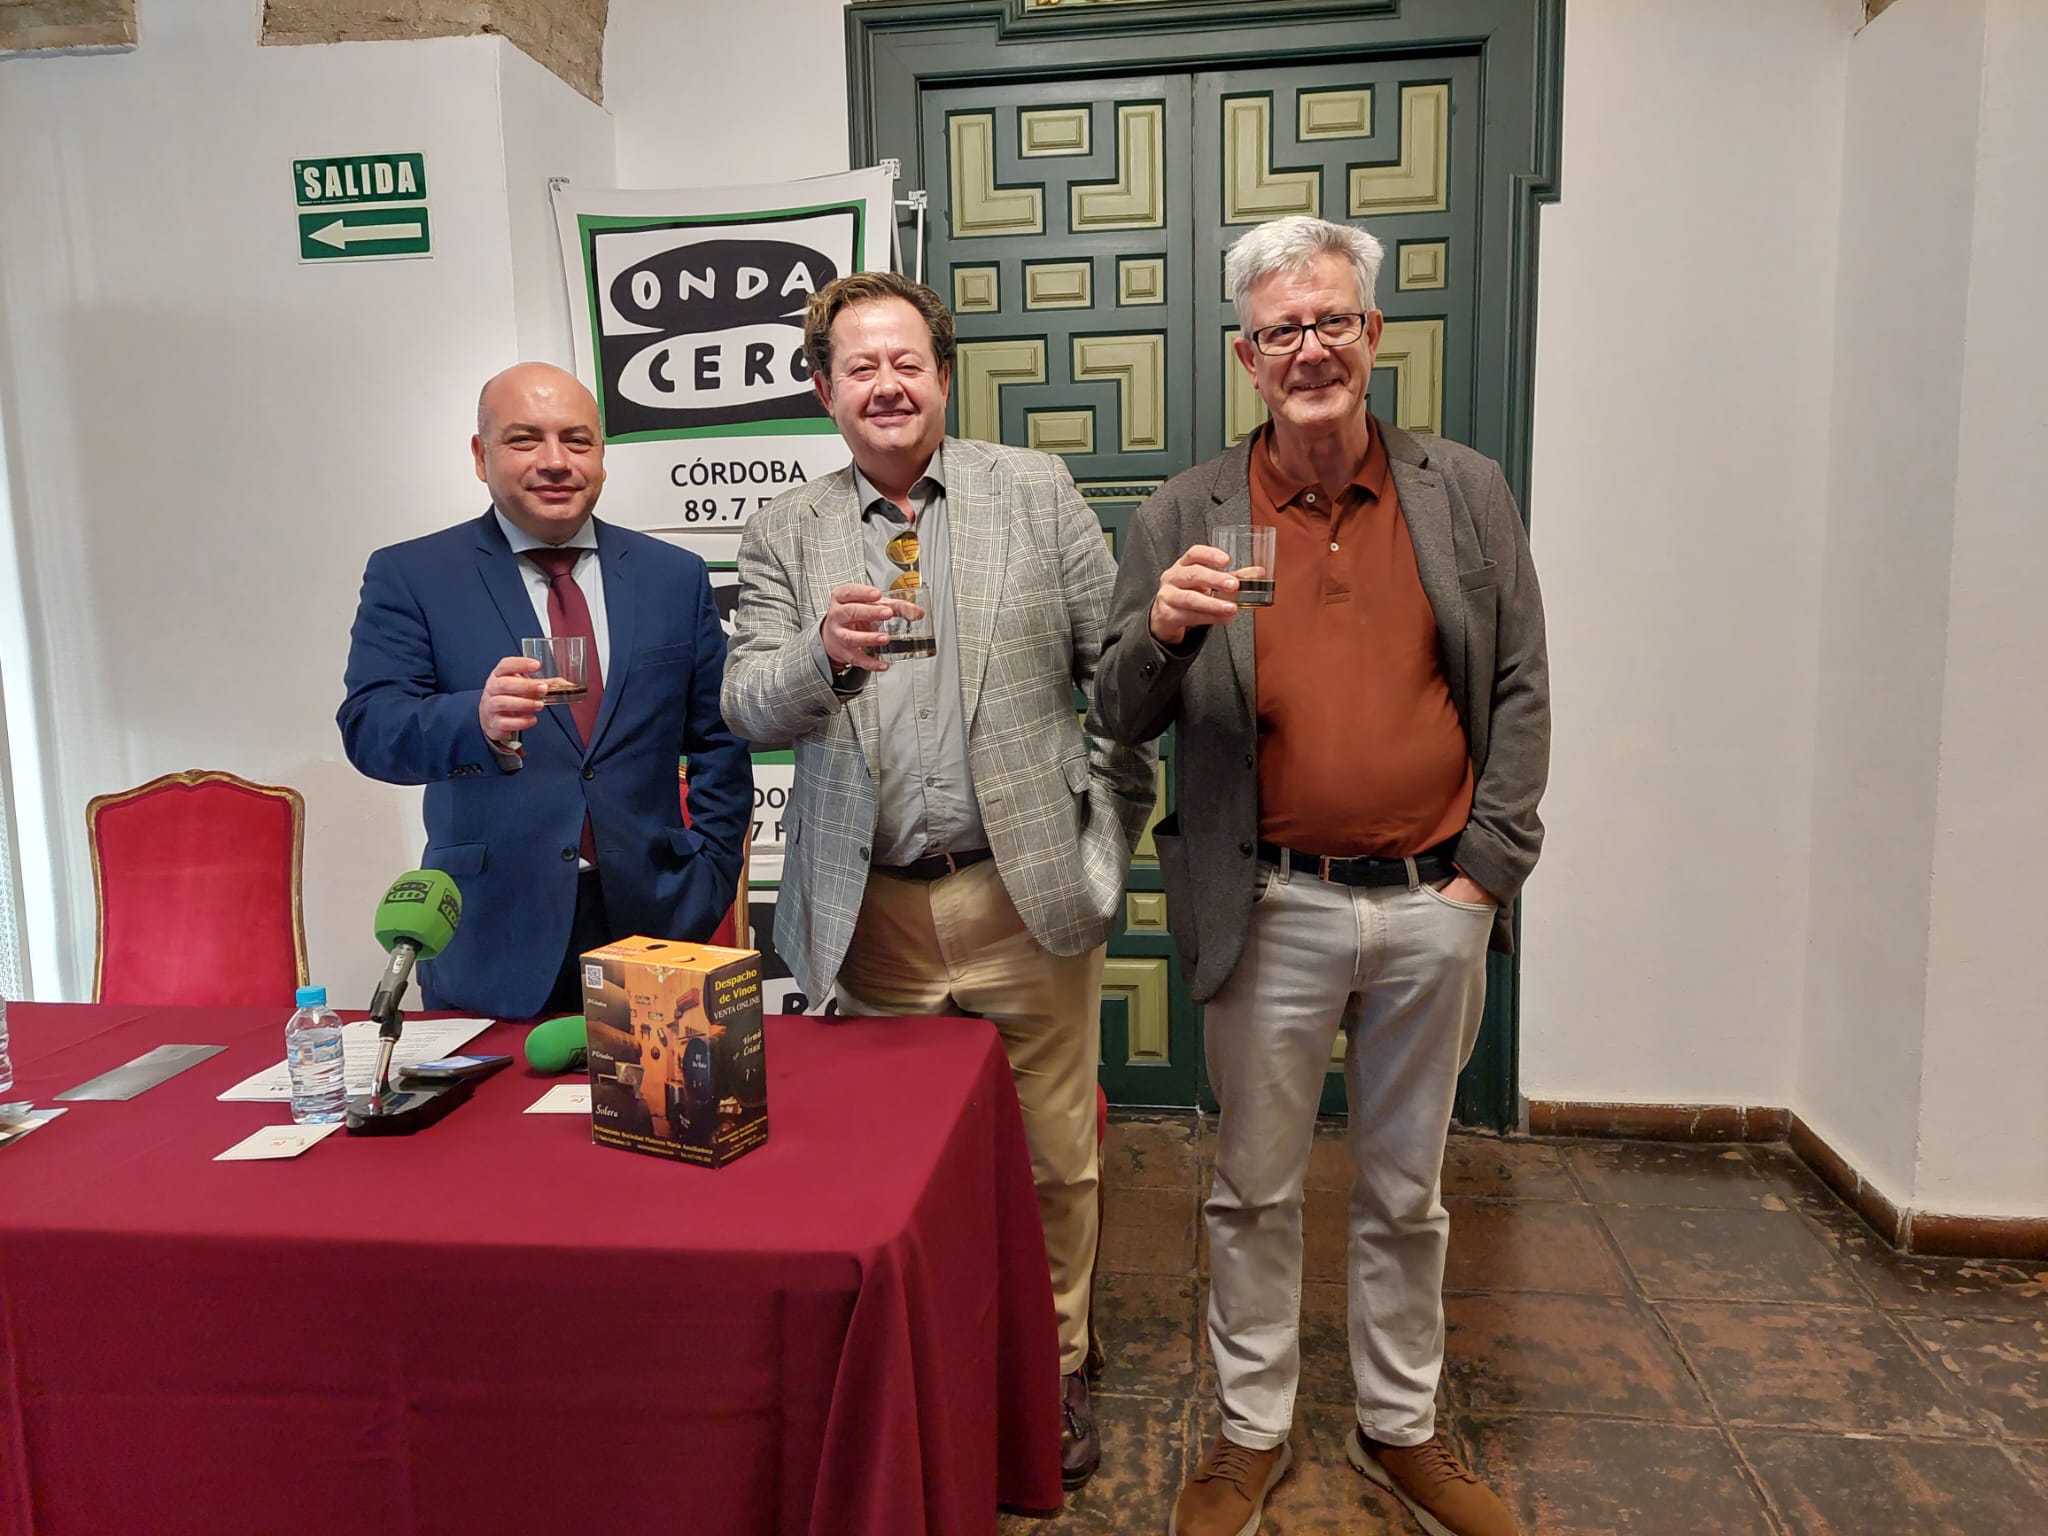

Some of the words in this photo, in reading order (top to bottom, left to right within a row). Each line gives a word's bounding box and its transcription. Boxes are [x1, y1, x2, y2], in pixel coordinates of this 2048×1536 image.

[303, 161, 417, 199] SALIDA
[631, 261, 815, 310] ONDA
[671, 457, 808, 487] CÓRDOBA
[684, 497, 746, 522] 89.7
[714, 968, 757, 992] Despacho
[719, 993, 731, 1005] de
[733, 983, 757, 1000] Vinos
[713, 1005, 736, 1020] VENTA
[736, 995, 761, 1012] ONLINE
[595, 1103, 619, 1118] Solera
